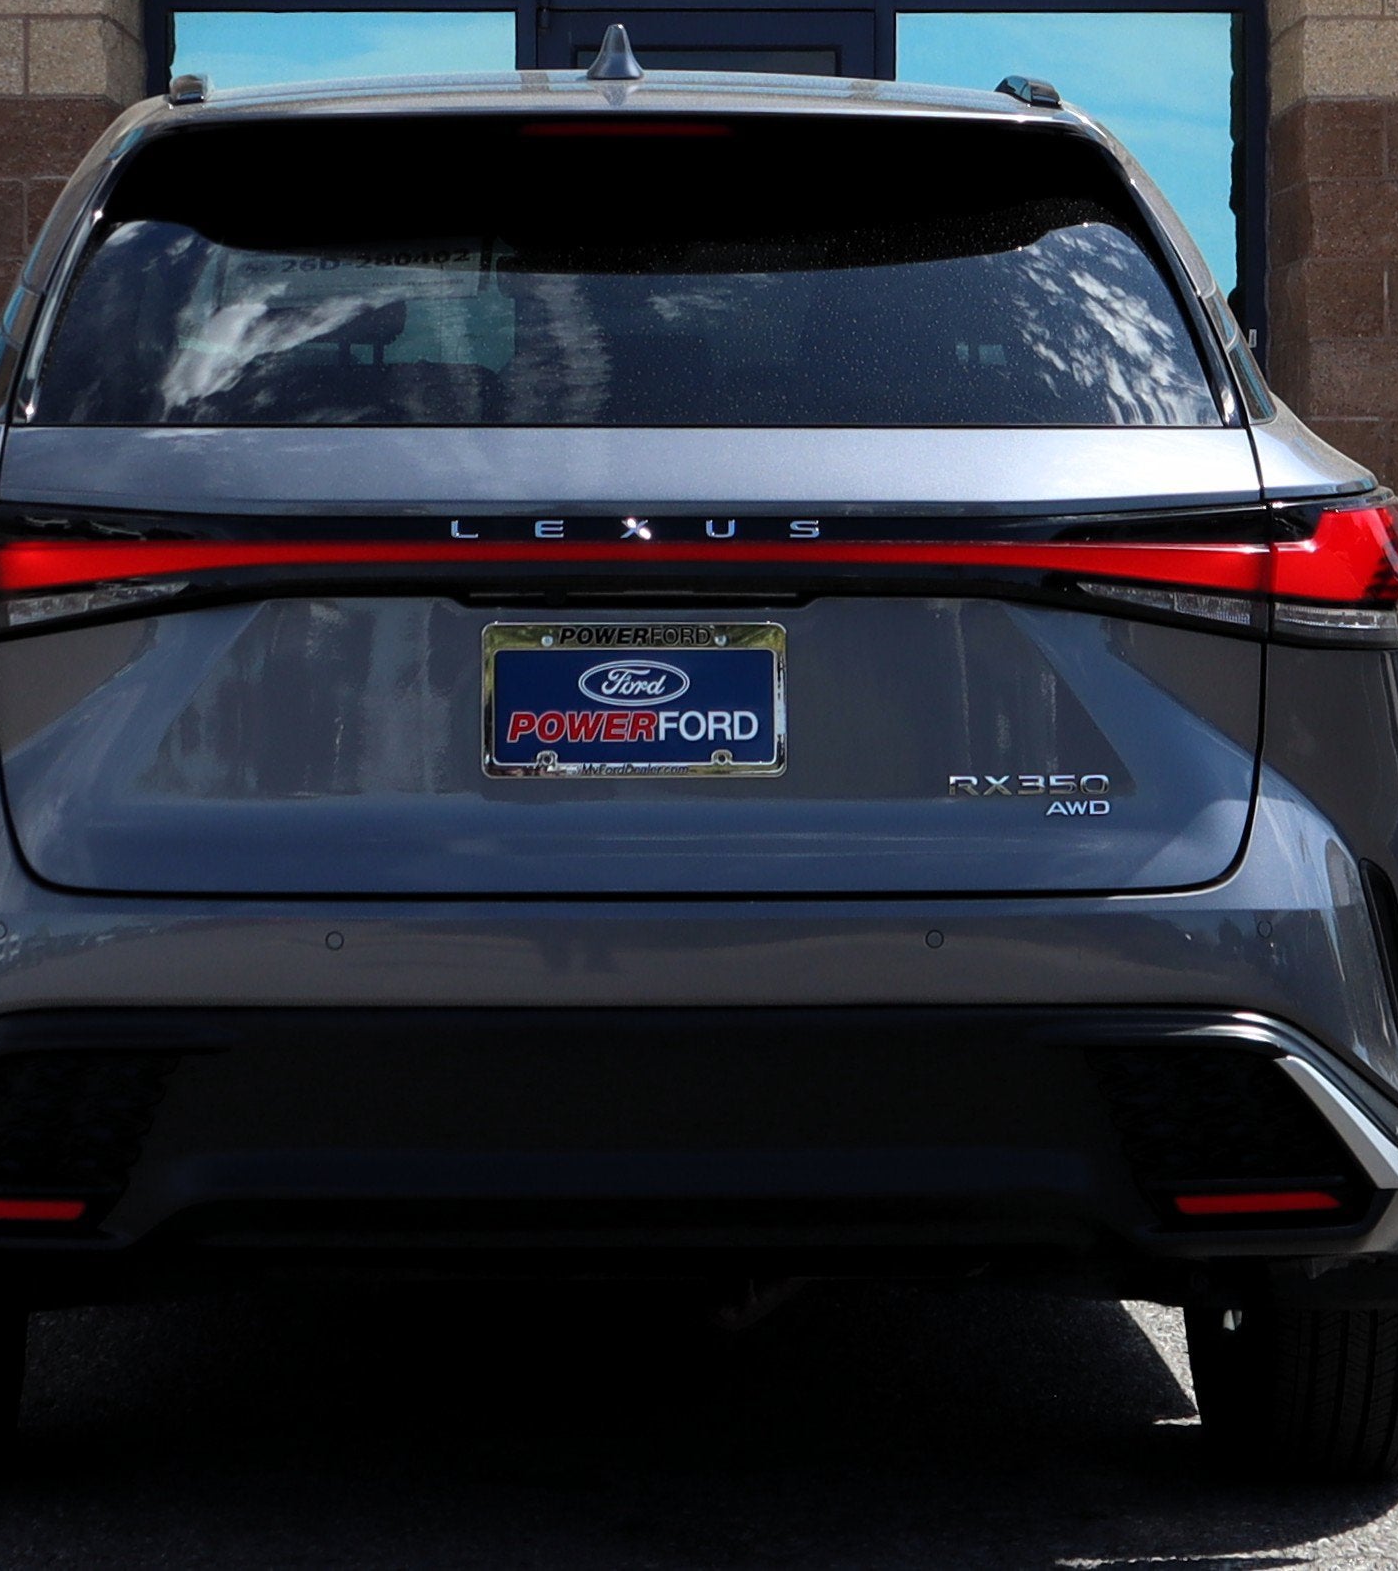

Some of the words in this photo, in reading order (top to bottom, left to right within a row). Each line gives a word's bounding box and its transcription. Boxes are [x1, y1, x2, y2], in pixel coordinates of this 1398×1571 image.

[450, 519, 820, 540] LEXUS
[559, 628, 712, 647] POWERFORD
[601, 669, 666, 696] Ford
[506, 710, 759, 743] POWERFORD
[1046, 800, 1110, 816] AWD
